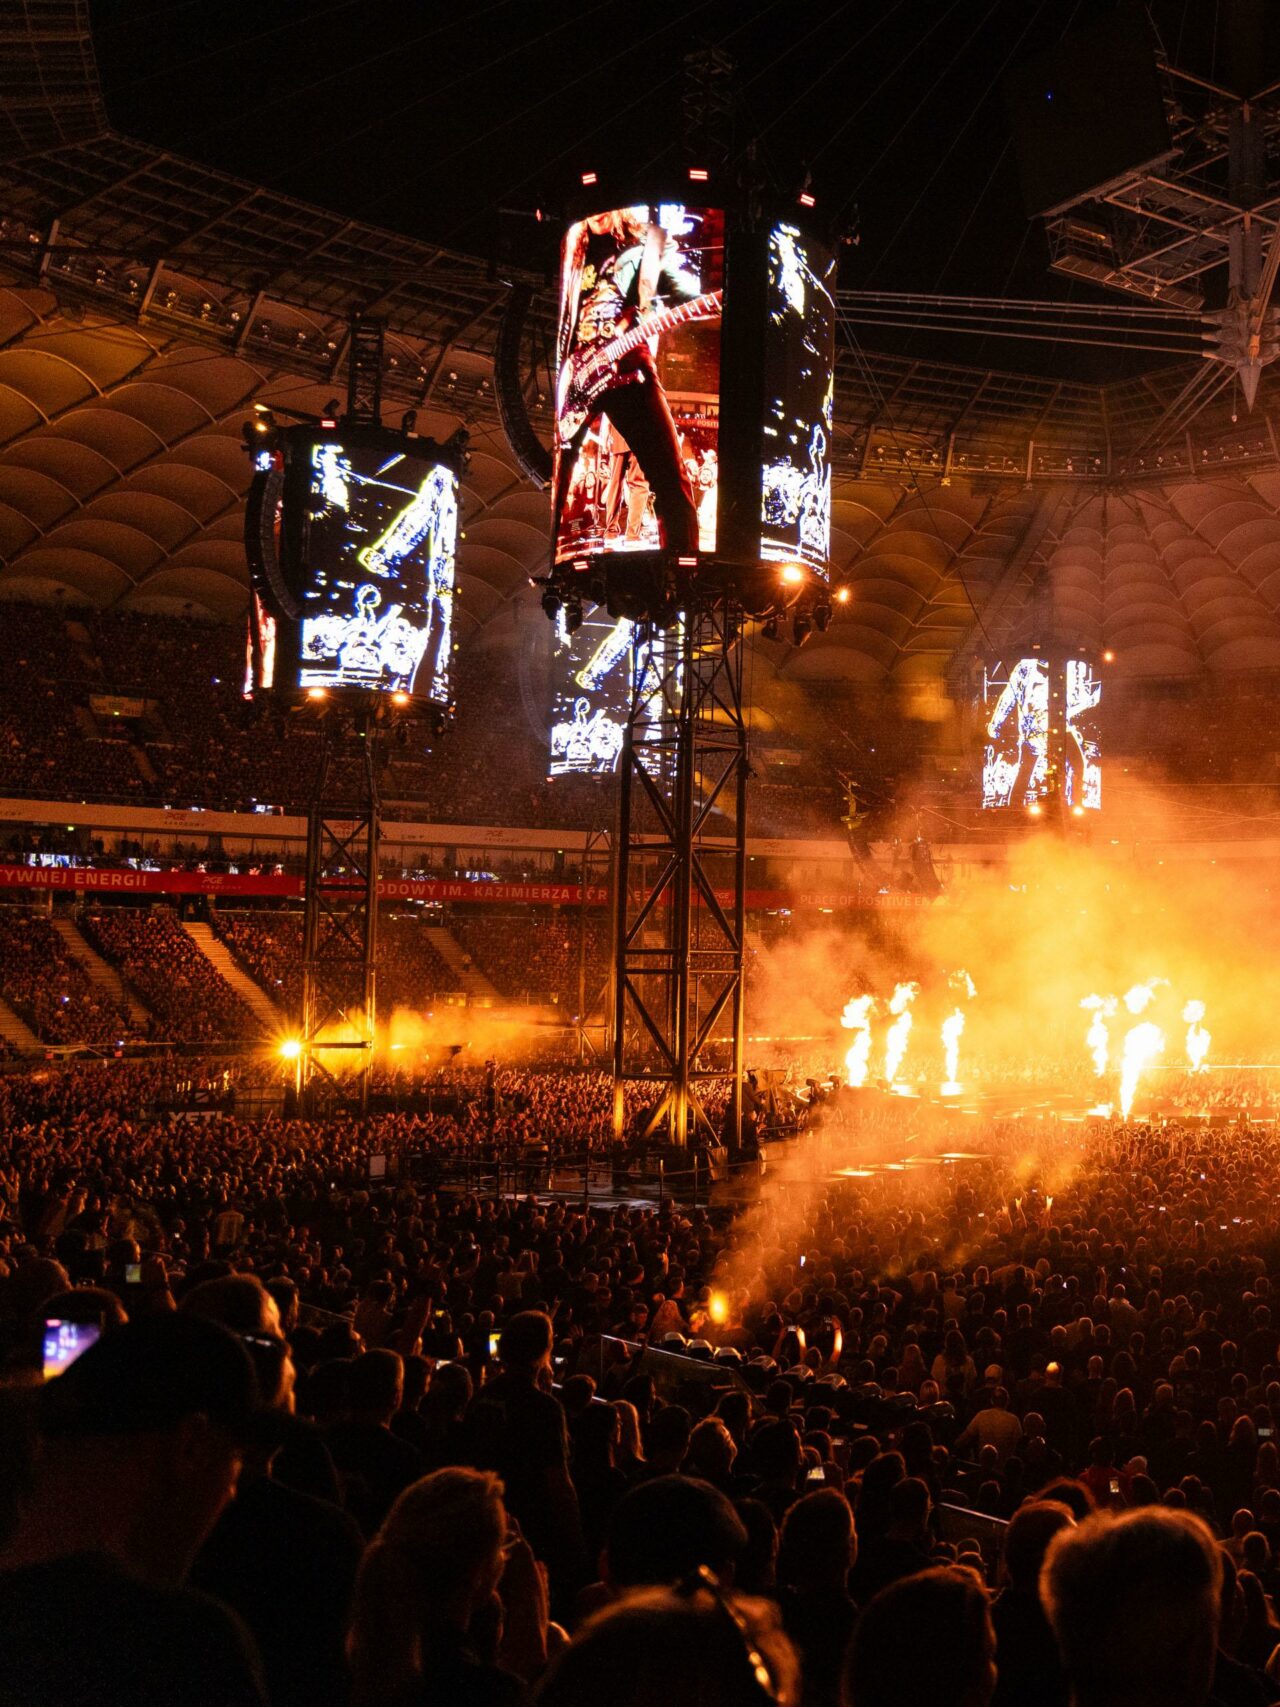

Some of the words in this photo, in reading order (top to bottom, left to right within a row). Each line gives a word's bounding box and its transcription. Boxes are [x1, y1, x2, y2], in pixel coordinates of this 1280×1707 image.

[165, 812, 188, 821] PGE
[74, 872, 147, 886] ENERGII
[203, 876, 225, 885] PGE
[442, 886, 467, 896] IM.
[475, 887, 570, 899] KAZIMIERZA
[800, 895, 836, 905] PLACE
[839, 896, 855, 905] OF
[858, 896, 911, 906] POSITIVE
[168, 1111, 223, 1123] YETI
